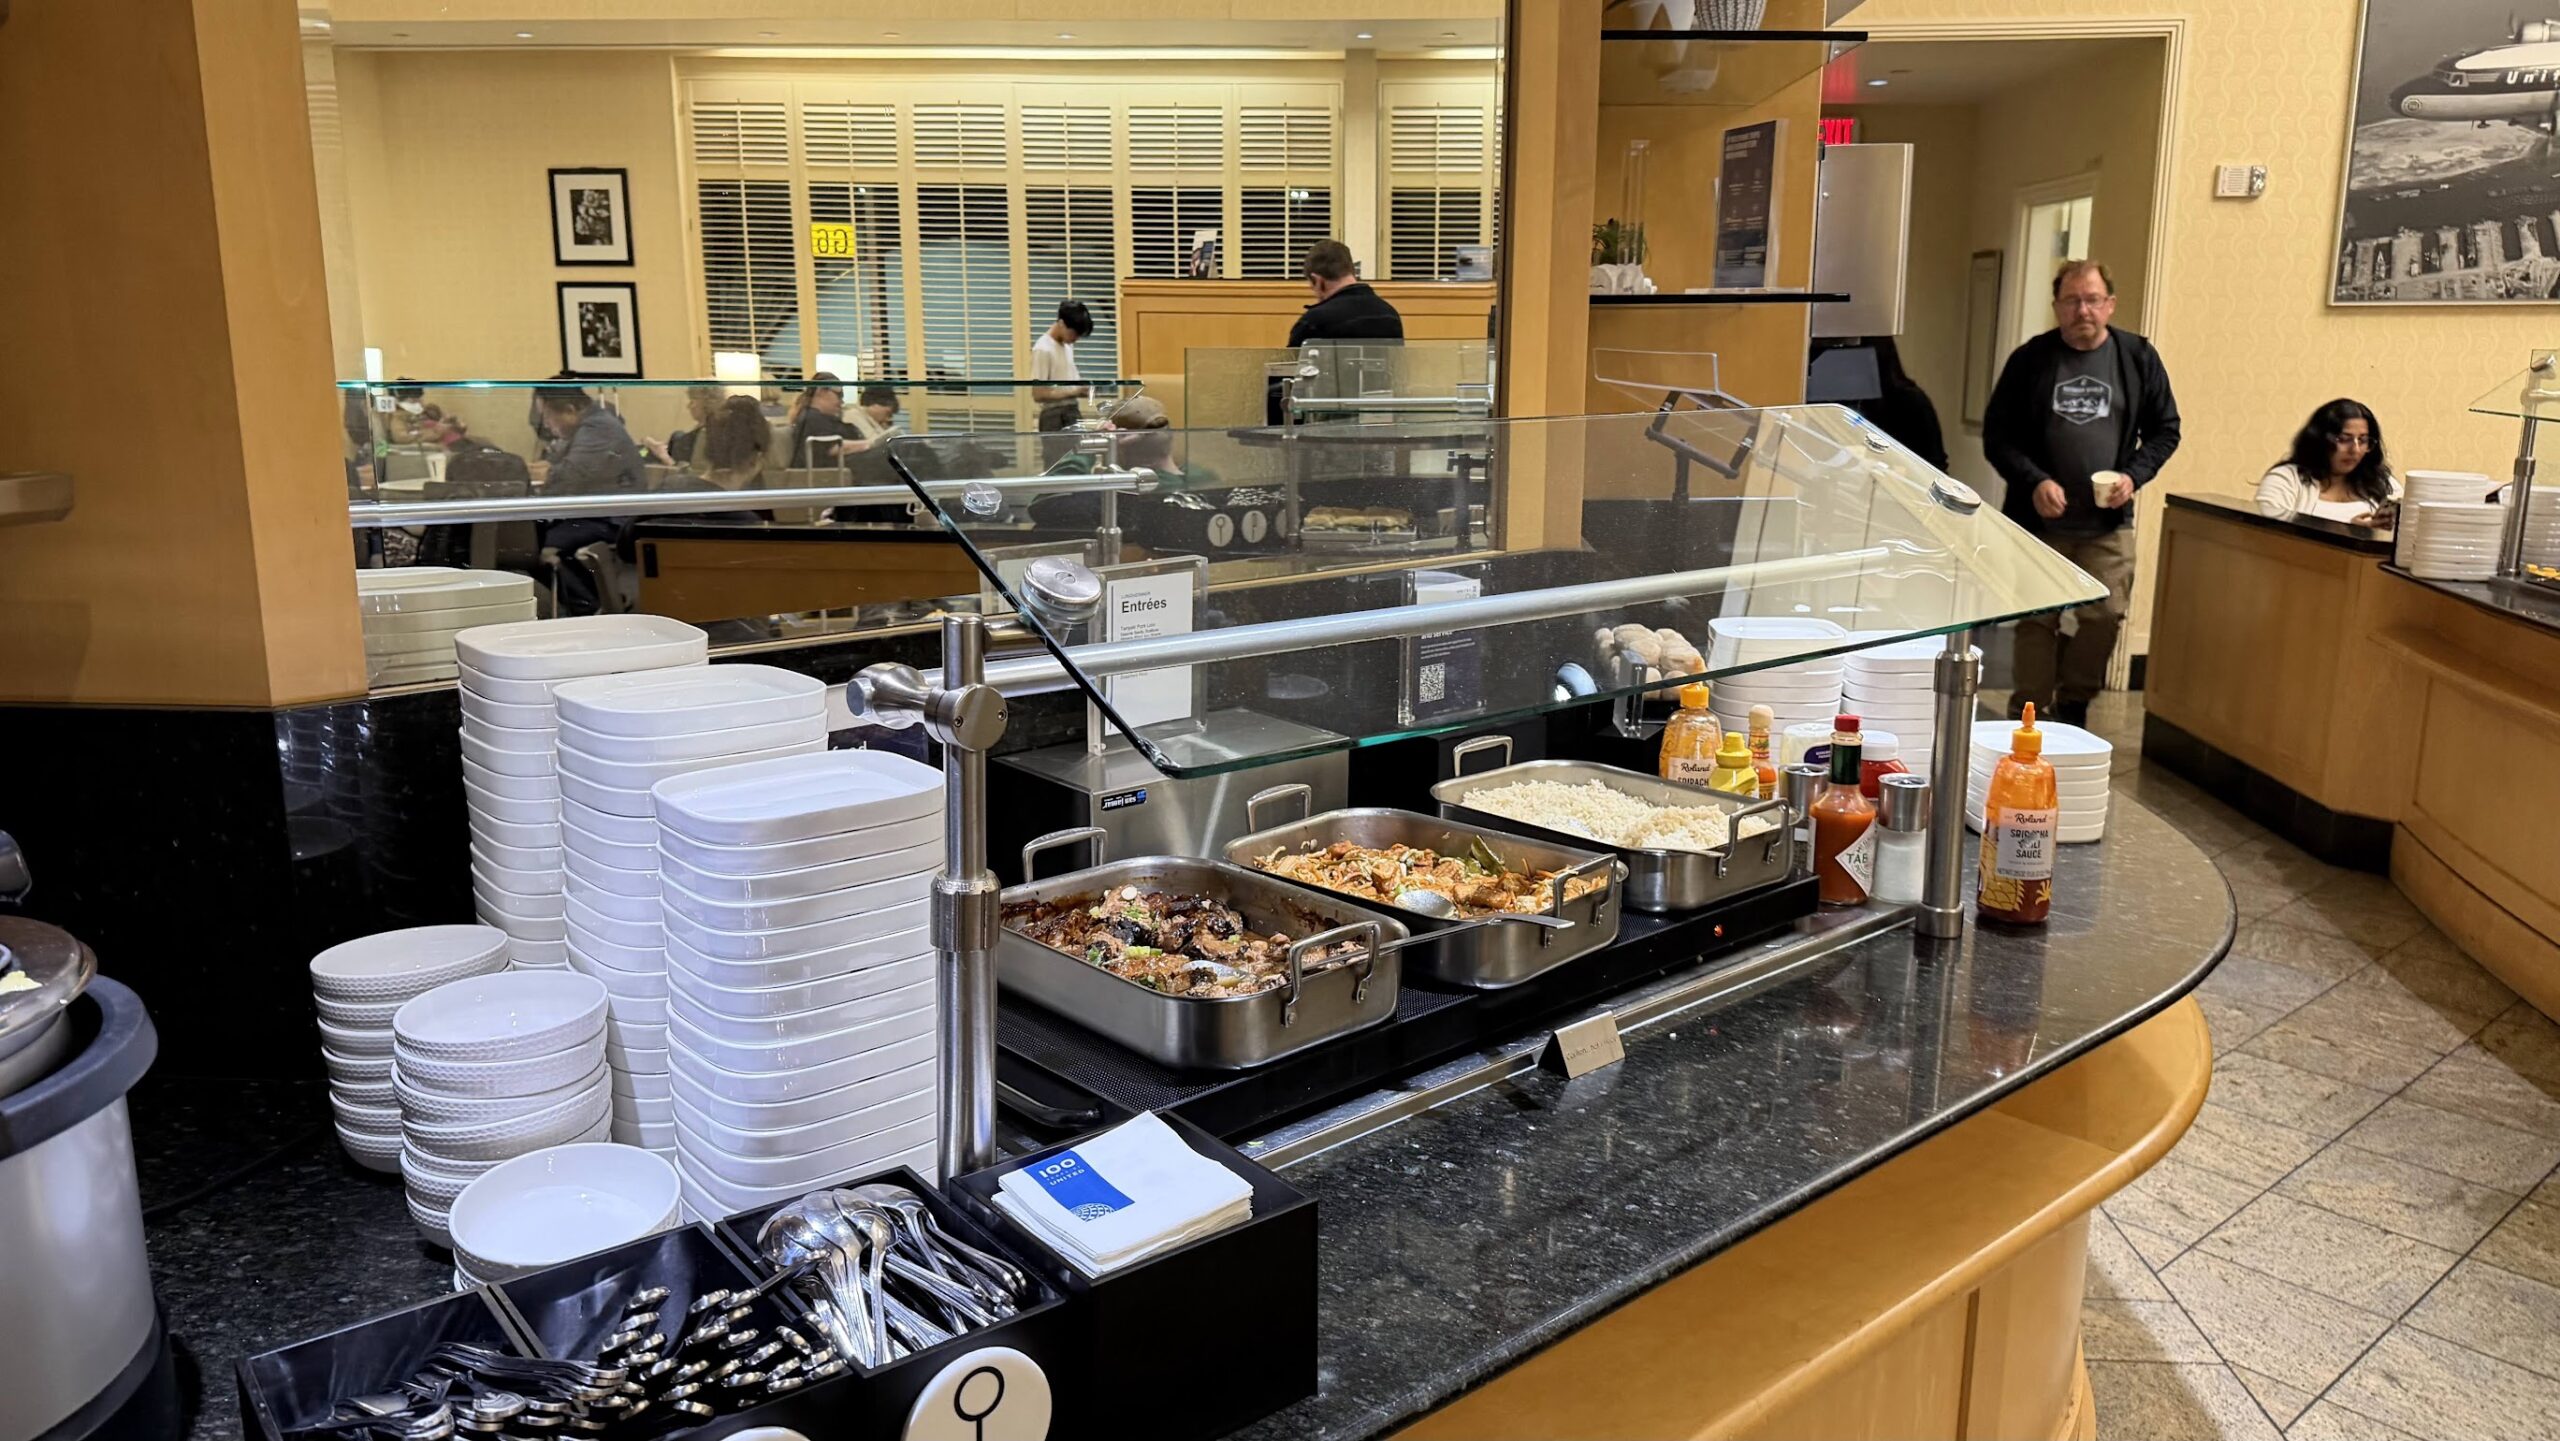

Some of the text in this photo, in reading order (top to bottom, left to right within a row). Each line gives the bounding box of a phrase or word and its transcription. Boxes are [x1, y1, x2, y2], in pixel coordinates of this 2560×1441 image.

[1121, 597, 1167, 614] Entrées
[1680, 762, 1711, 773] Roland
[2014, 812, 2048, 824] Roland
[2015, 849, 2042, 859] SAUCE
[1038, 1158, 1076, 1178] 100
[1049, 1169, 1086, 1186] UNITED
